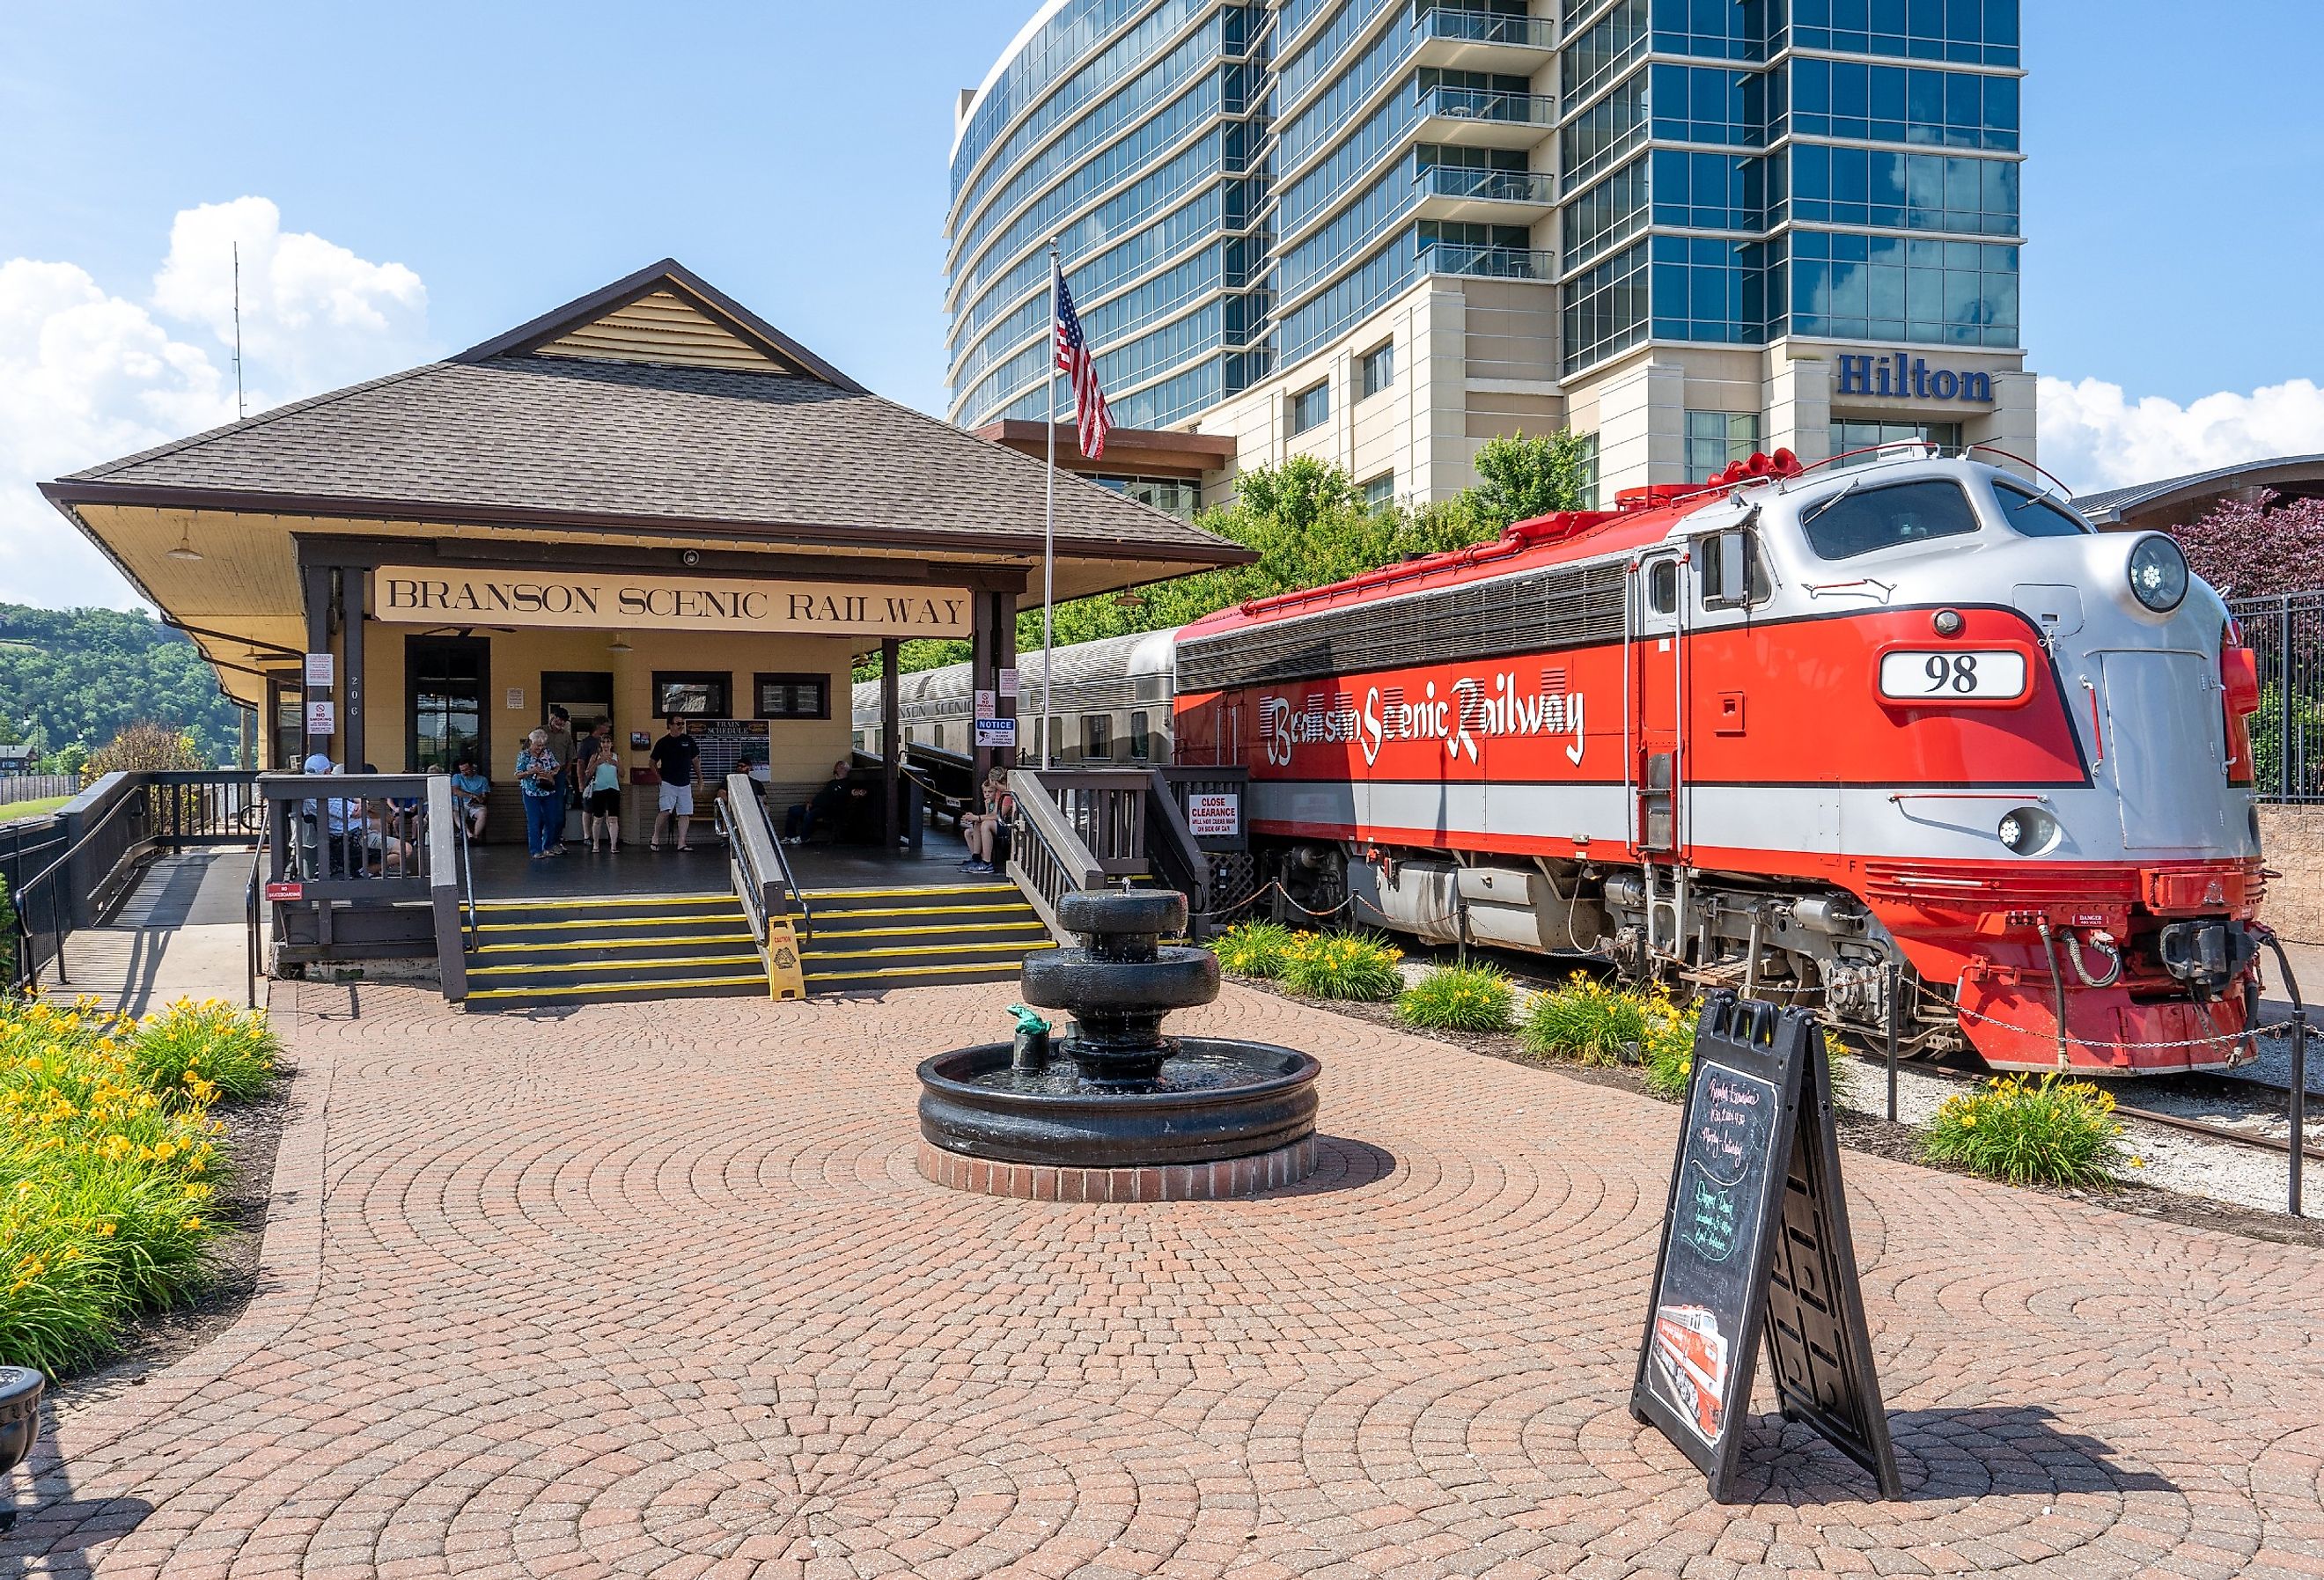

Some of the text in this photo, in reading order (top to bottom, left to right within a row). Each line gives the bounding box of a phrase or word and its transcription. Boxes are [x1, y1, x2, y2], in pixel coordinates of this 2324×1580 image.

[1838, 353, 1993, 401] Hilton
[387, 580, 963, 626] BRANSON SCENIC RAILWAY
[1924, 655, 1977, 693] 98
[1268, 672, 1585, 767] Branson Scenic Railway
[1192, 807, 1235, 817] CLEARANCE
[1202, 797, 1225, 806] CLOSE
[1850, 860, 1856, 872] F
